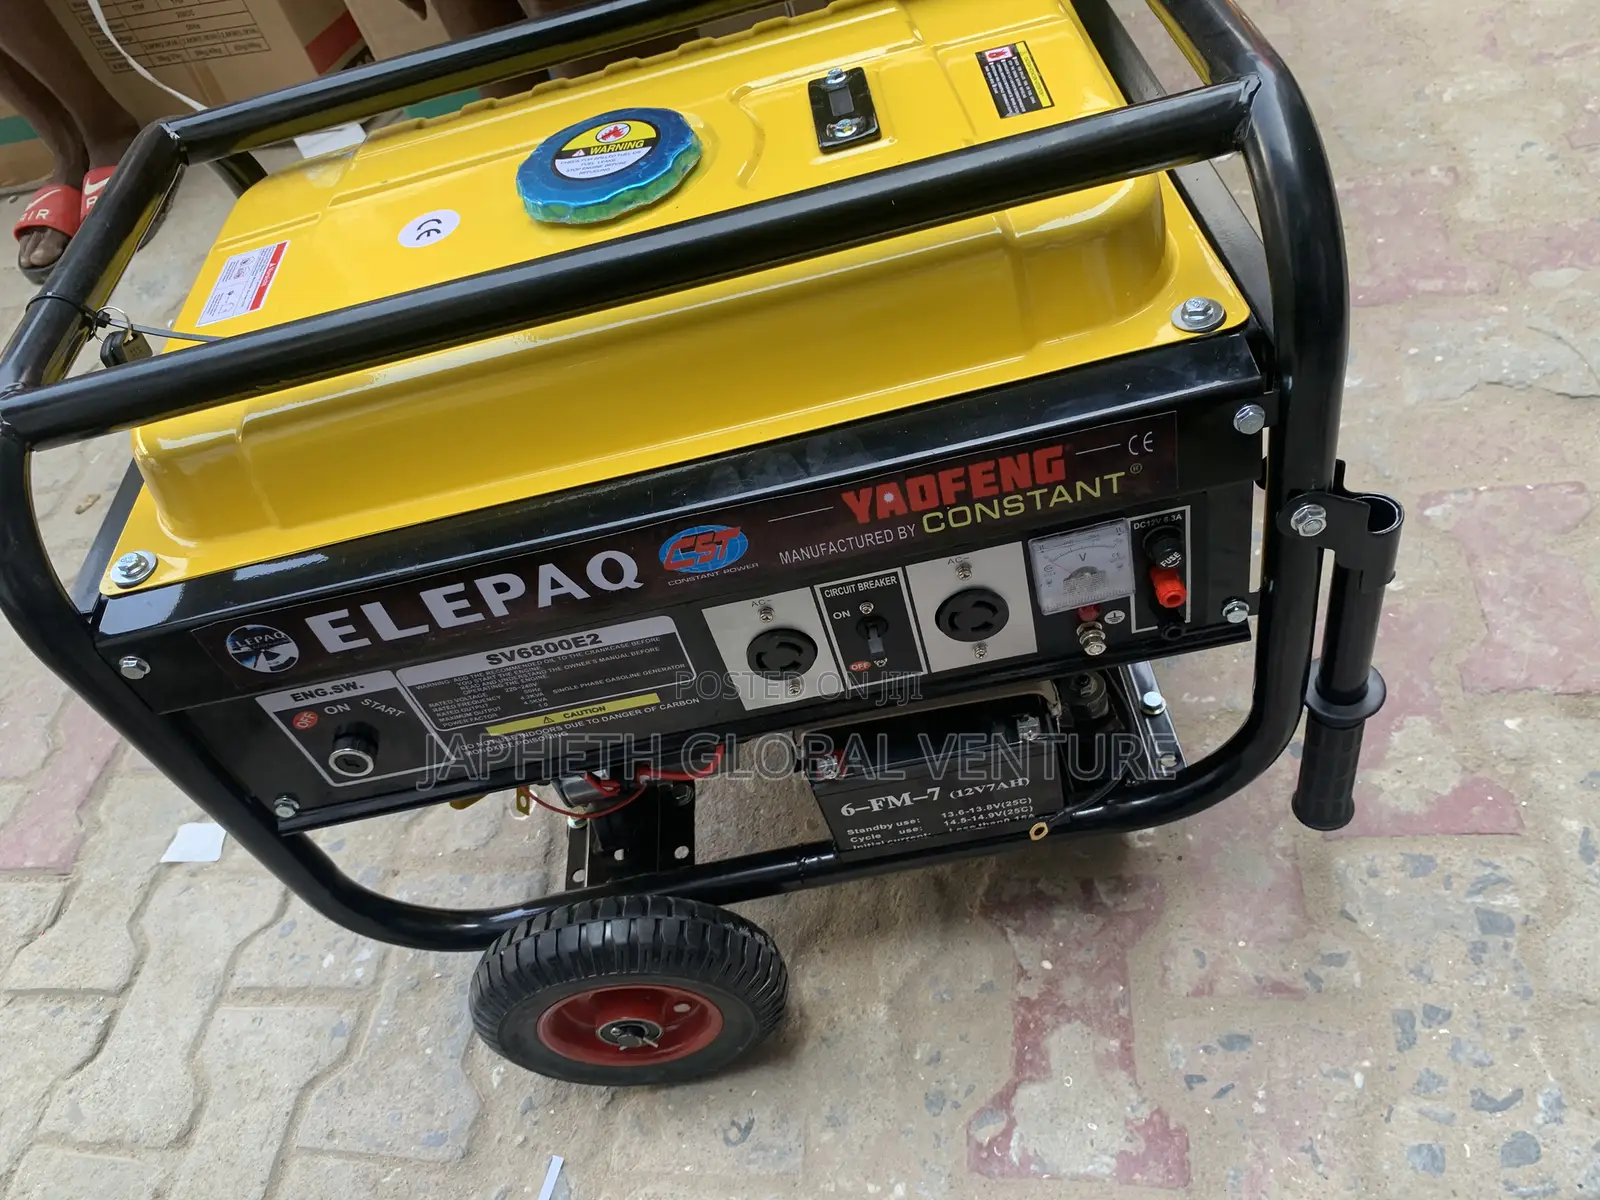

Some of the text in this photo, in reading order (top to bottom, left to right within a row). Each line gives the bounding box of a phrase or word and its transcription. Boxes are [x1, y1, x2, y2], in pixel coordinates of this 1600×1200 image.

[590, 140, 644, 154] WARNING
[840, 444, 1067, 524] YAOFENG
[779, 471, 1126, 565] MANUFACTURED BY CONSTANT
[1133, 518, 1161, 530] DC12V
[663, 526, 741, 571] CST
[1160, 551, 1181, 568] FUSE
[668, 562, 759, 586] CONSTANT POWER
[824, 575, 898, 598] CIRCUIT BREAKER
[305, 550, 644, 654] ELEPAQ
[833, 609, 851, 620] ON
[486, 633, 602, 665] SV6800E2
[453, 674, 469, 682] ADD
[470, 671, 483, 679] THE
[486, 660, 543, 677] RECOMMENDED
[584, 643, 630, 656] CRANKCASE
[631, 636, 661, 646] BEFORE
[850, 662, 870, 671] OFF
[460, 646, 660, 692] READ AND UNDERSTAND THE OWNER'S MANUAL BEFORE
[457, 679, 473, 687] YOU
[474, 674, 498, 685] START
[499, 670, 515, 679] THE
[290, 681, 365, 702] ENG.SW.
[436, 708, 460, 718] RATED
[460, 703, 489, 713] OUTPUT
[552, 685, 579, 695] SINGLE
[580, 679, 605, 688] PHASE
[605, 671, 641, 683] GASOLINE
[642, 663, 686, 676] GENERATOR
[462, 683, 505, 696] OPERATING
[505, 681, 519, 689] THE
[324, 703, 352, 715] ON
[361, 698, 406, 717] START
[429, 698, 454, 708] RATED
[454, 692, 488, 703] VOLTAGE
[432, 703, 457, 713] RATED
[457, 695, 501, 708] FREQUENCY
[297, 712, 316, 728] OFF
[438, 712, 475, 722] MAXIMUM
[475, 706, 502, 716] OUTPUT
[442, 718, 468, 728] POWER
[468, 713, 498, 723] FACTOR
[563, 705, 606, 719] CAUTION
[460, 743, 474, 751] DO
[564, 720, 585, 730] DUE
[586, 717, 600, 726] TO
[601, 710, 642, 722] DANGER
[644, 705, 658, 713] OF
[659, 697, 700, 711] CARBON
[840, 777, 1030, 817] 6-FM-7 (12V7AH)
[847, 822, 893, 835] Standby
[896, 818, 920, 827] use:
[850, 833, 882, 844] Cycle
[899, 826, 923, 835] use:
